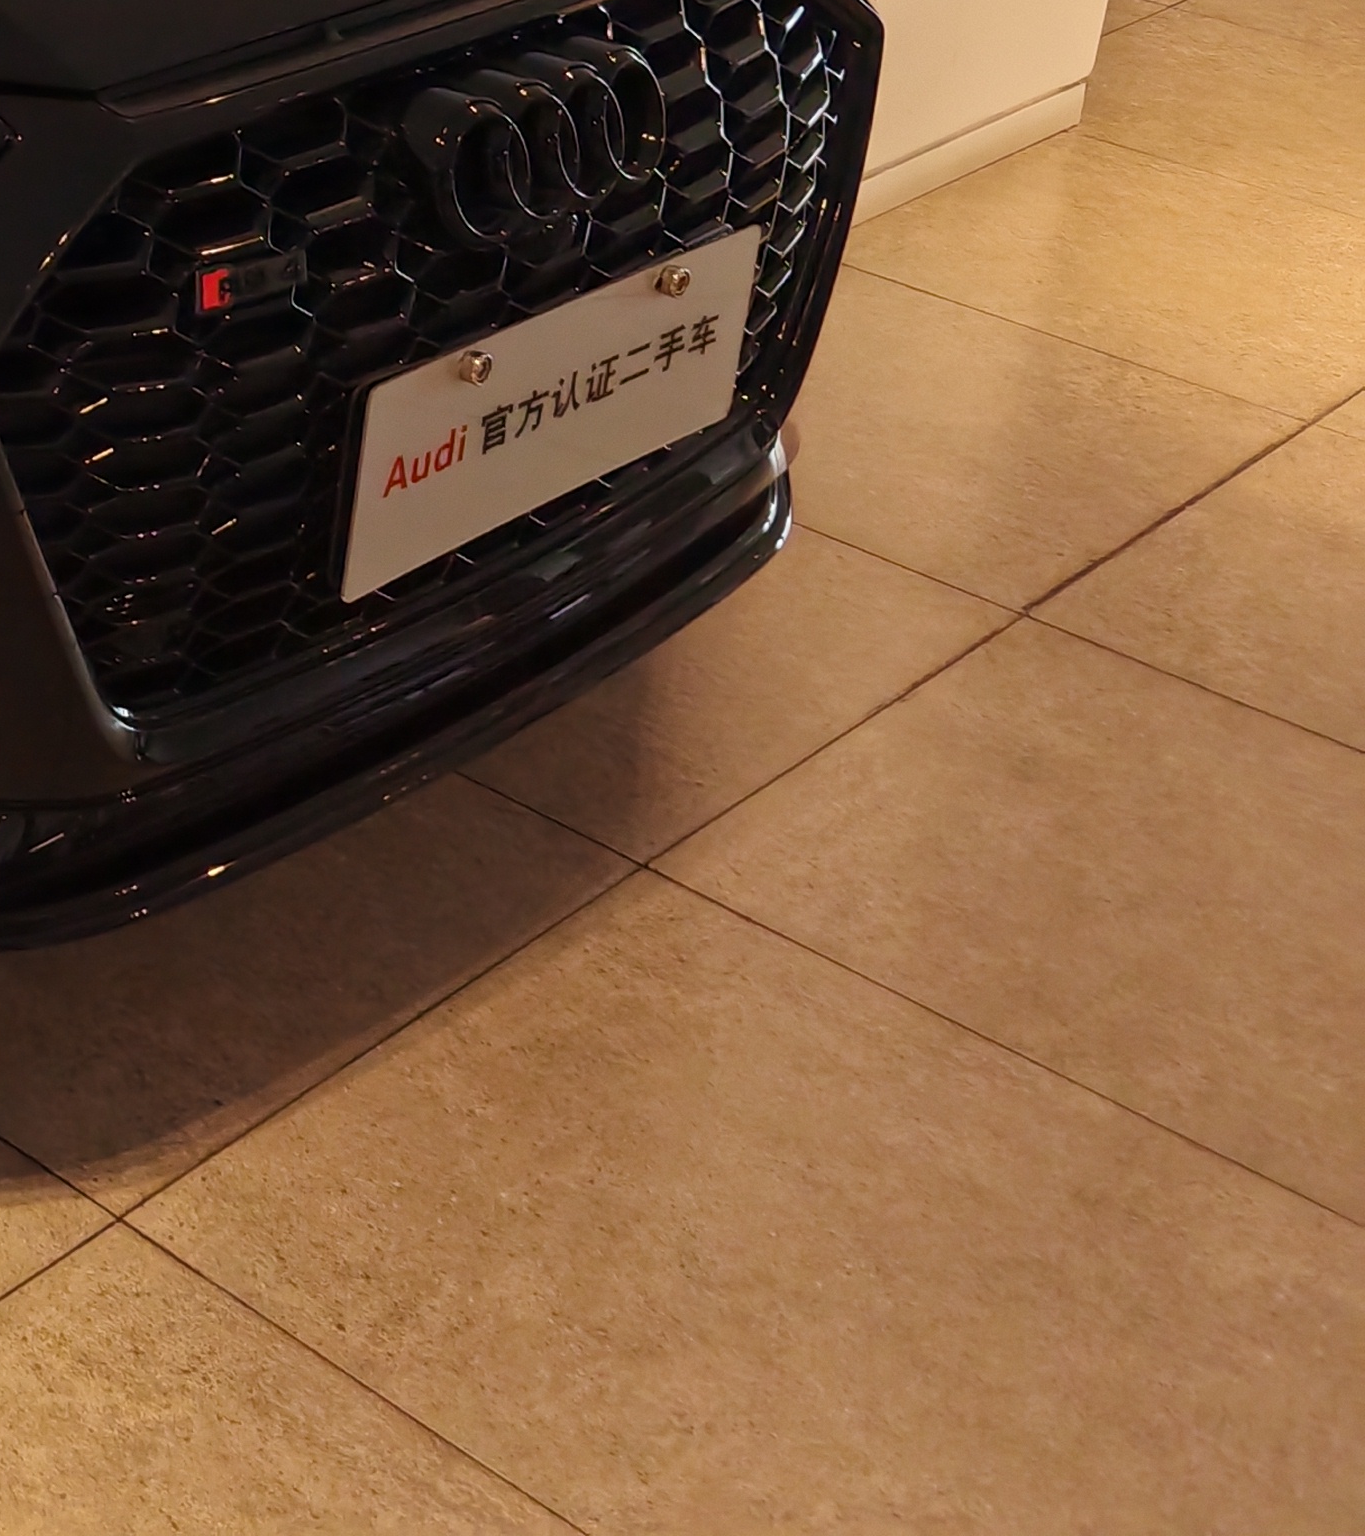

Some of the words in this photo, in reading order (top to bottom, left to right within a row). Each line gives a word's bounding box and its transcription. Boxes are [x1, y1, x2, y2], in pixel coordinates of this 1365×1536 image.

[382, 424, 468, 498] Audi
[480, 314, 720, 455] 官方认证二手车
